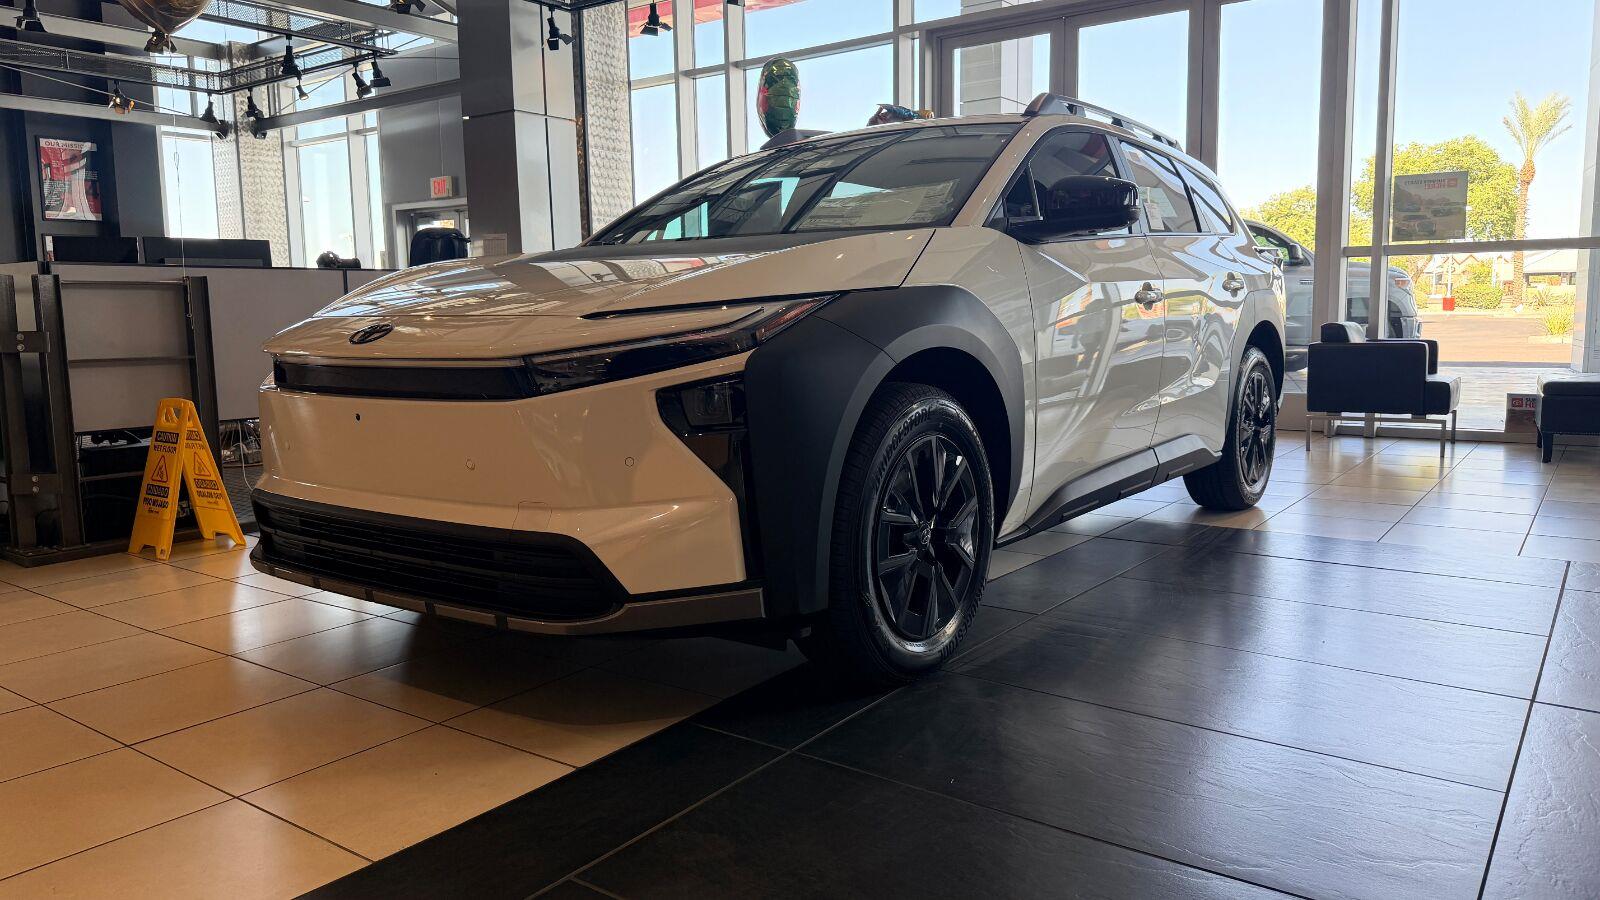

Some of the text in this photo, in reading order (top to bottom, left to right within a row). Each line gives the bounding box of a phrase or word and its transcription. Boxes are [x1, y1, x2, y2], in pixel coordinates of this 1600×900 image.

[434, 178, 446, 195] EXIT
[156, 432, 177, 443] CAUTION
[153, 444, 163, 452] WET
[163, 445, 177, 455] FLOOR
[147, 484, 169, 497] CUIDADO
[143, 497, 169, 509] PISO MOJADO
